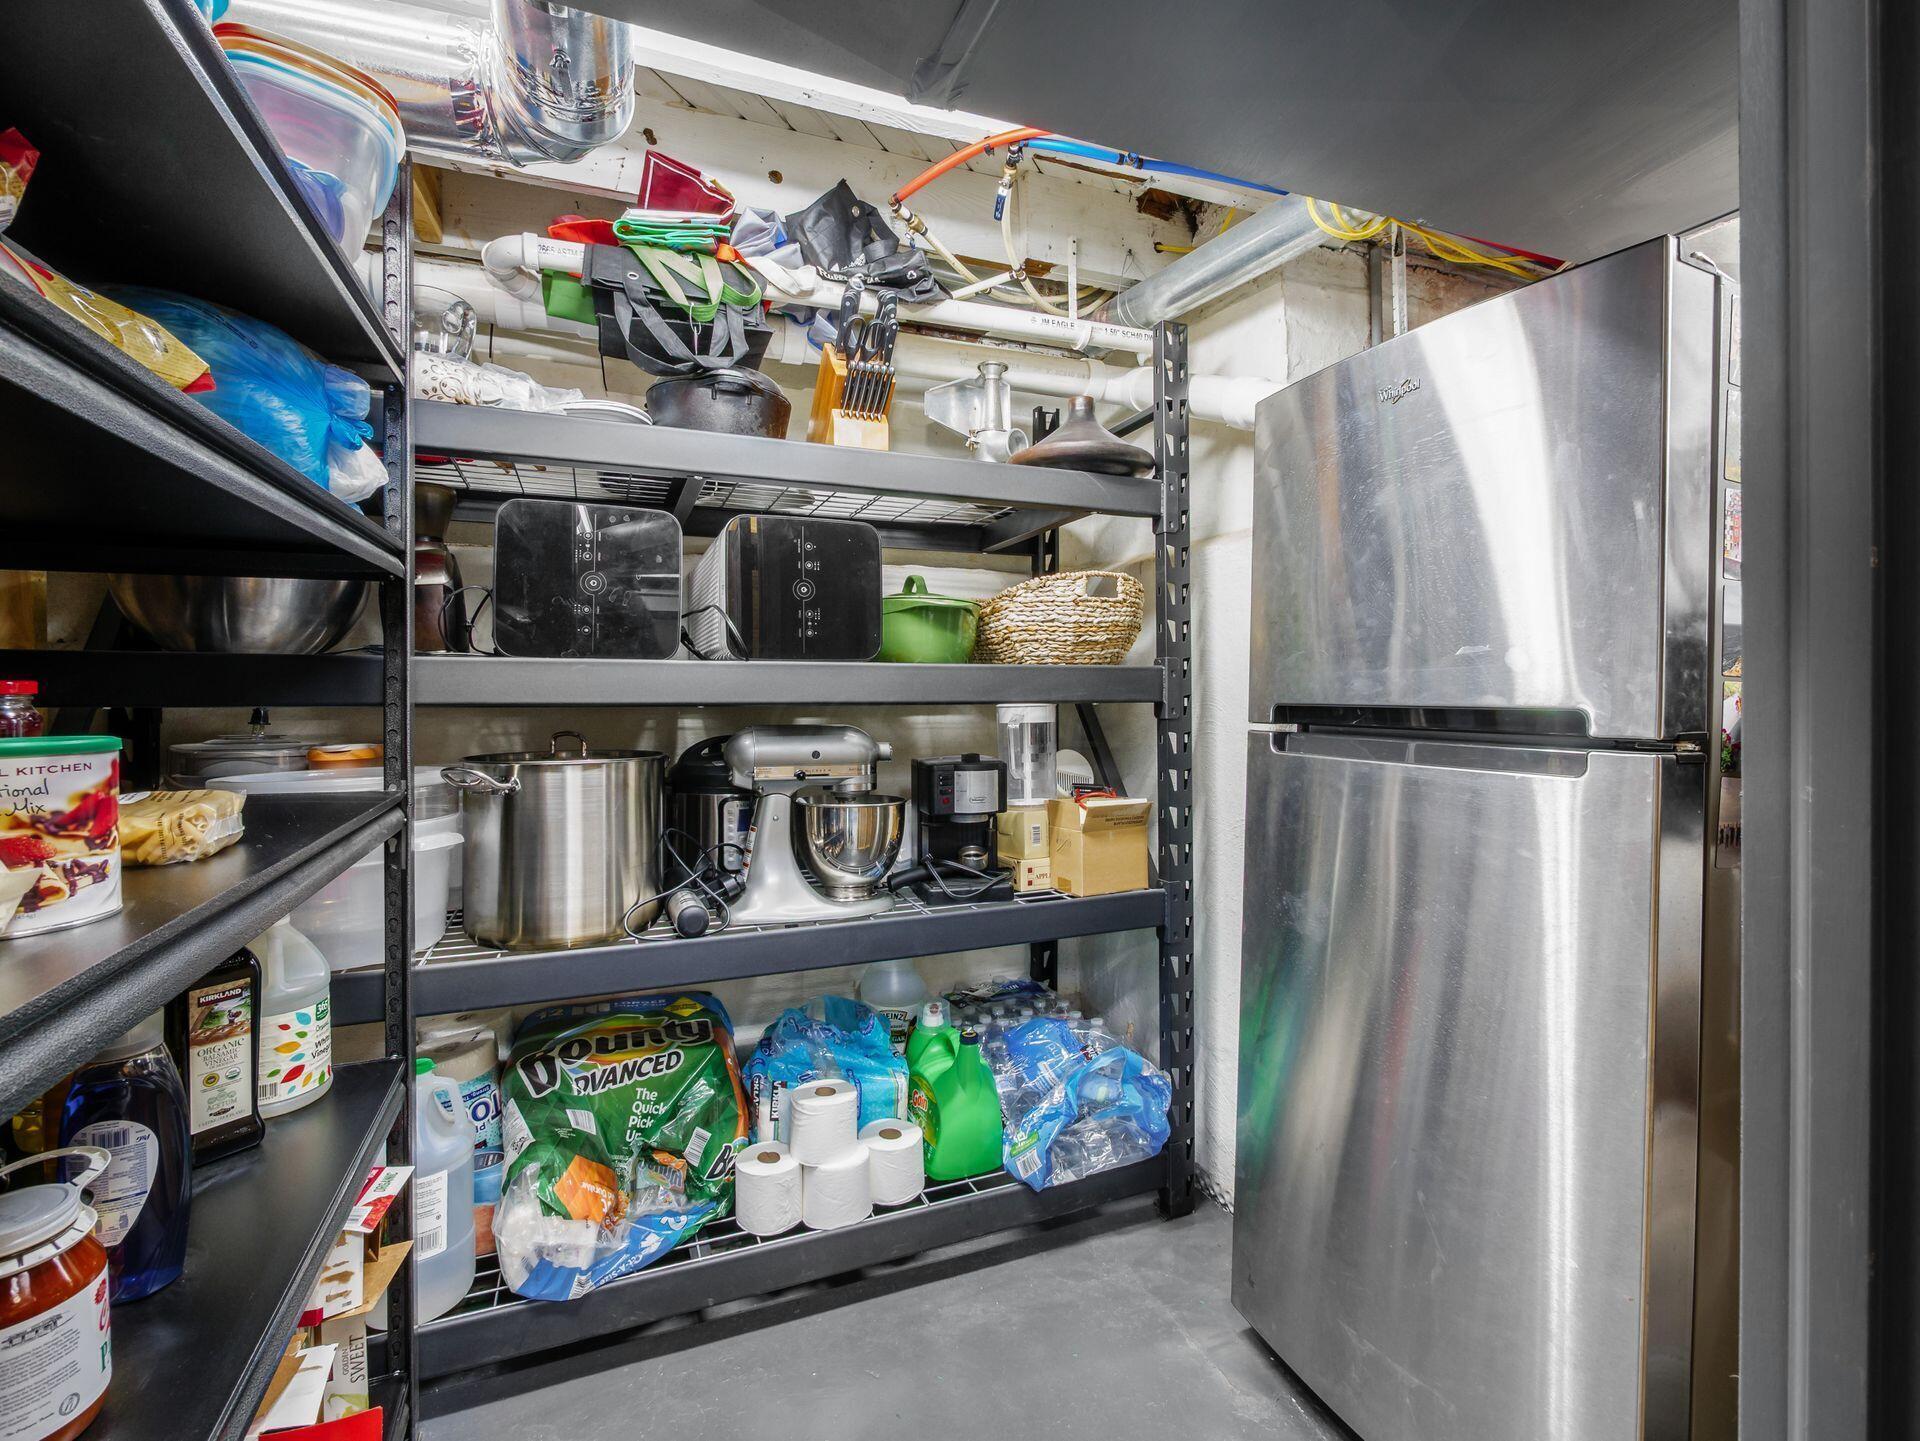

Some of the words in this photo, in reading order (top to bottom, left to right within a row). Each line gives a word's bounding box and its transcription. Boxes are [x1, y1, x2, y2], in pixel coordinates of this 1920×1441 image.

[1051, 319, 1075, 329] EAGLE
[1379, 377, 1421, 405] Whirlpool
[16, 762, 92, 776] KITCHEN
[5, 797, 47, 816] Mix
[199, 988, 243, 1004] KIRKLAND
[197, 1039, 243, 1058] ORGANIC
[573, 1050, 682, 1096] DVANCED
[636, 1087, 658, 1101] The
[912, 1089, 928, 1111] Gain
[632, 1101, 667, 1115] Quick
[628, 1116, 655, 1129] Pick
[349, 1334, 366, 1384] SWEET
